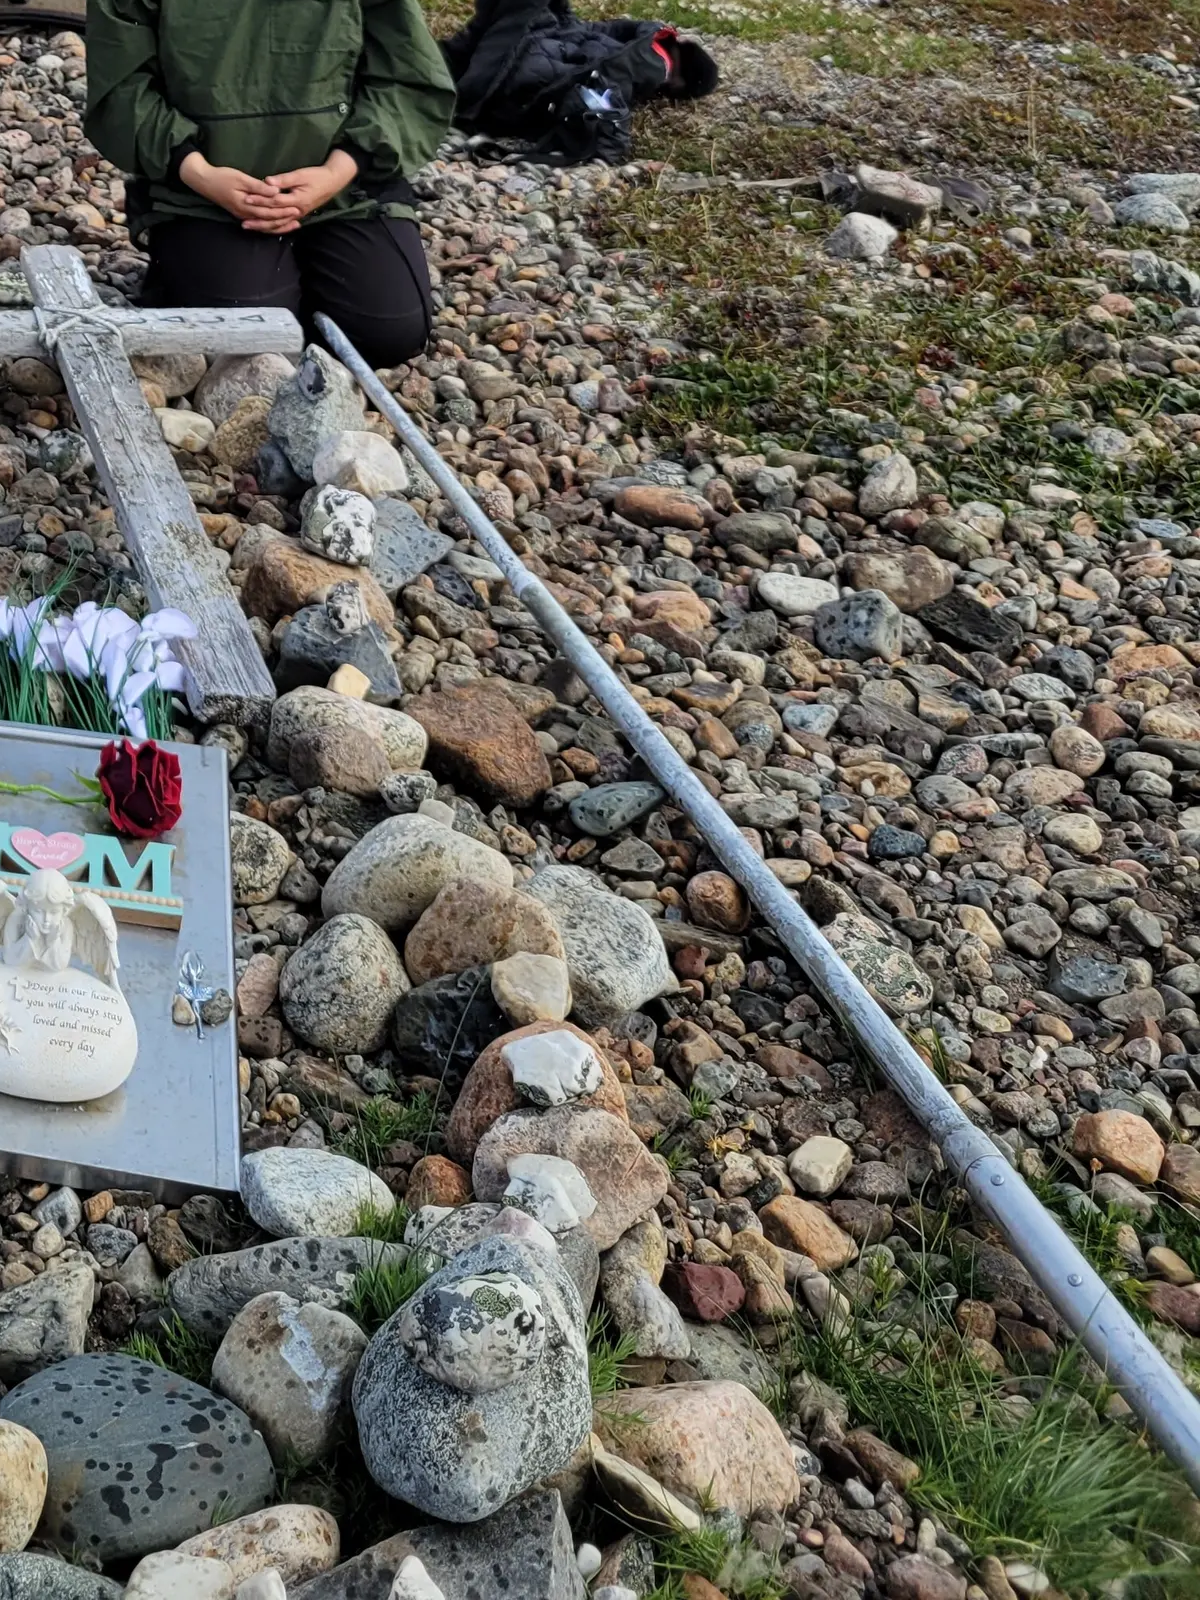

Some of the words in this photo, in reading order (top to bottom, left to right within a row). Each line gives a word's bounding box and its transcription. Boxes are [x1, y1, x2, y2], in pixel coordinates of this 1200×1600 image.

[23, 981, 55, 994] Deep
[58, 985, 68, 993] in
[71, 988, 88, 997] our
[91, 990, 119, 1004] hearts
[26, 999, 44, 1009] you
[48, 999, 67, 1010] will
[68, 1002, 99, 1019] always
[103, 1011, 123, 1025] stay
[33, 1013, 59, 1027] loved
[60, 1019, 80, 1030] and
[81, 1024, 113, 1038] missed
[49, 1036, 74, 1053] every
[77, 1040, 95, 1058] day
